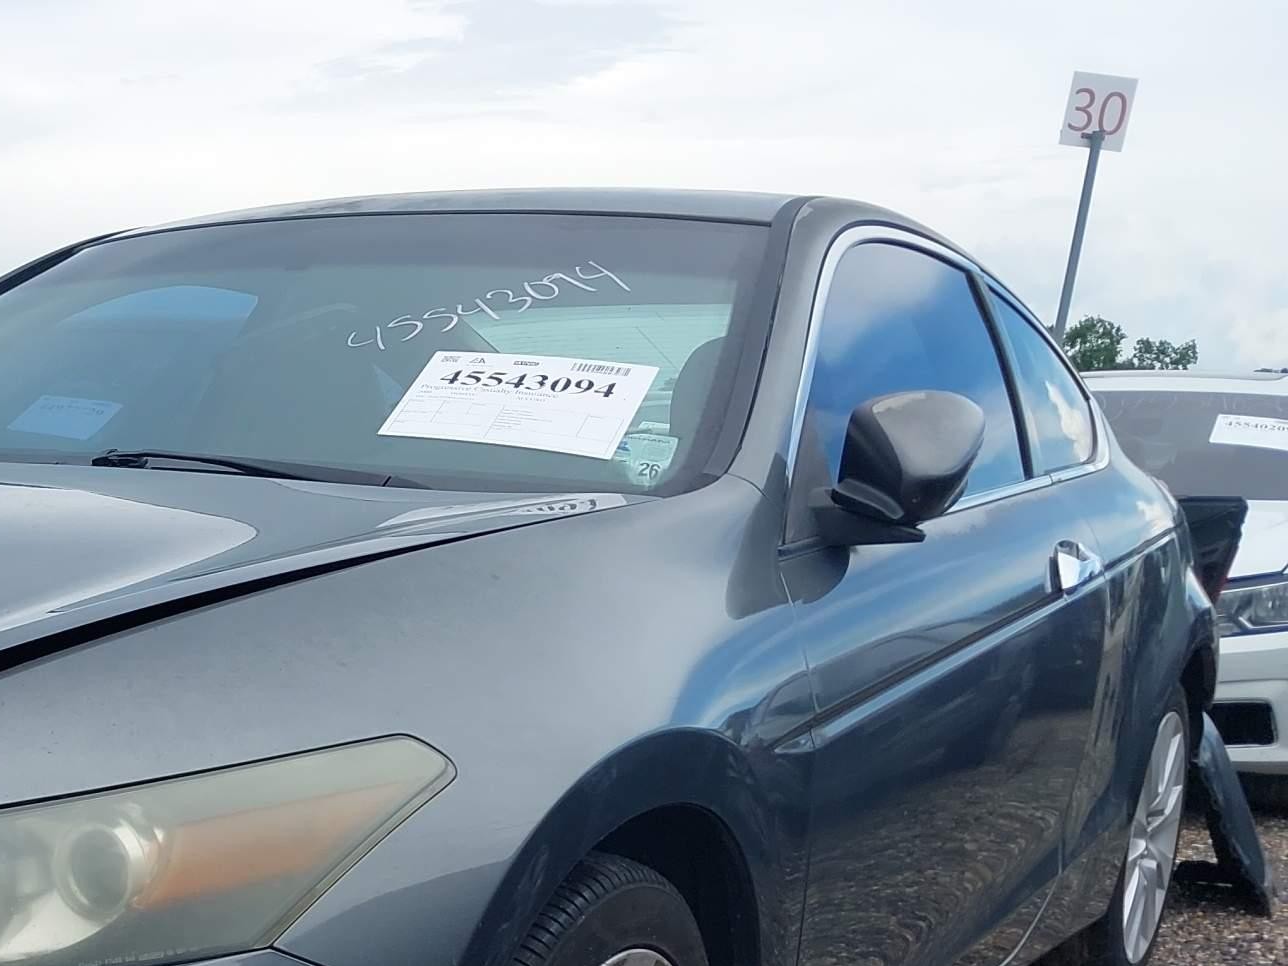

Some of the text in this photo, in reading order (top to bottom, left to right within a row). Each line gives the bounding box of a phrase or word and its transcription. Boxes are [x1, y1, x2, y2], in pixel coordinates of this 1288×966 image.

[1067, 87, 1128, 136] 30
[346, 260, 631, 350] 45543094
[439, 369, 617, 398] 45543094
[1224, 420, 1288, 431] 4554020
[638, 462, 661, 480] 26
